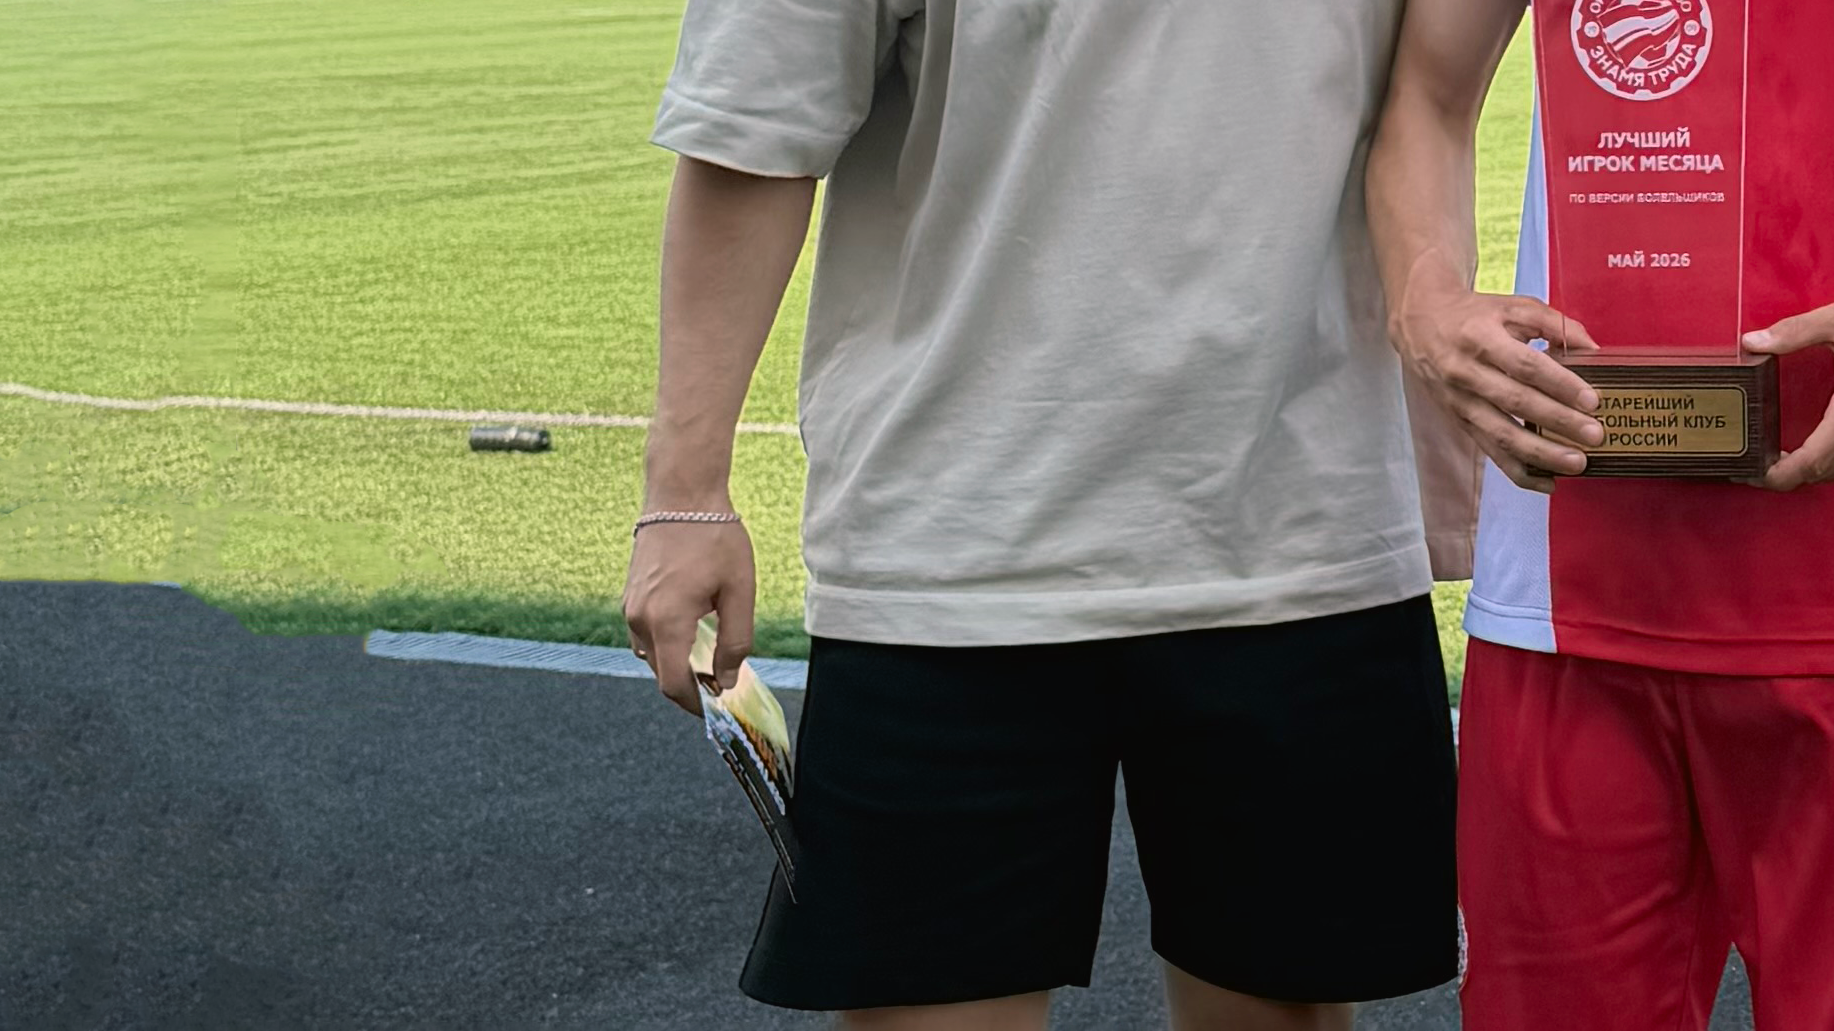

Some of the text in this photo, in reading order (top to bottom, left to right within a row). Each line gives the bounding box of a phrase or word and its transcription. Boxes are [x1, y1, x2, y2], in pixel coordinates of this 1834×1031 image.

[1590, 43, 1697, 87] ЗНАМЯ ТРУДА
[1597, 126, 1691, 149] ЛУЧШИЙ
[1568, 154, 1725, 174] ИГРОК МЕСЯЦА
[1569, 193, 1586, 204] ПО
[1588, 192, 1634, 204] ВЕРСИИ
[1607, 250, 1691, 268] МАЙ 2026
[1683, 414, 1727, 429] КЛУБ
[1608, 432, 1678, 447] РОССИИ
